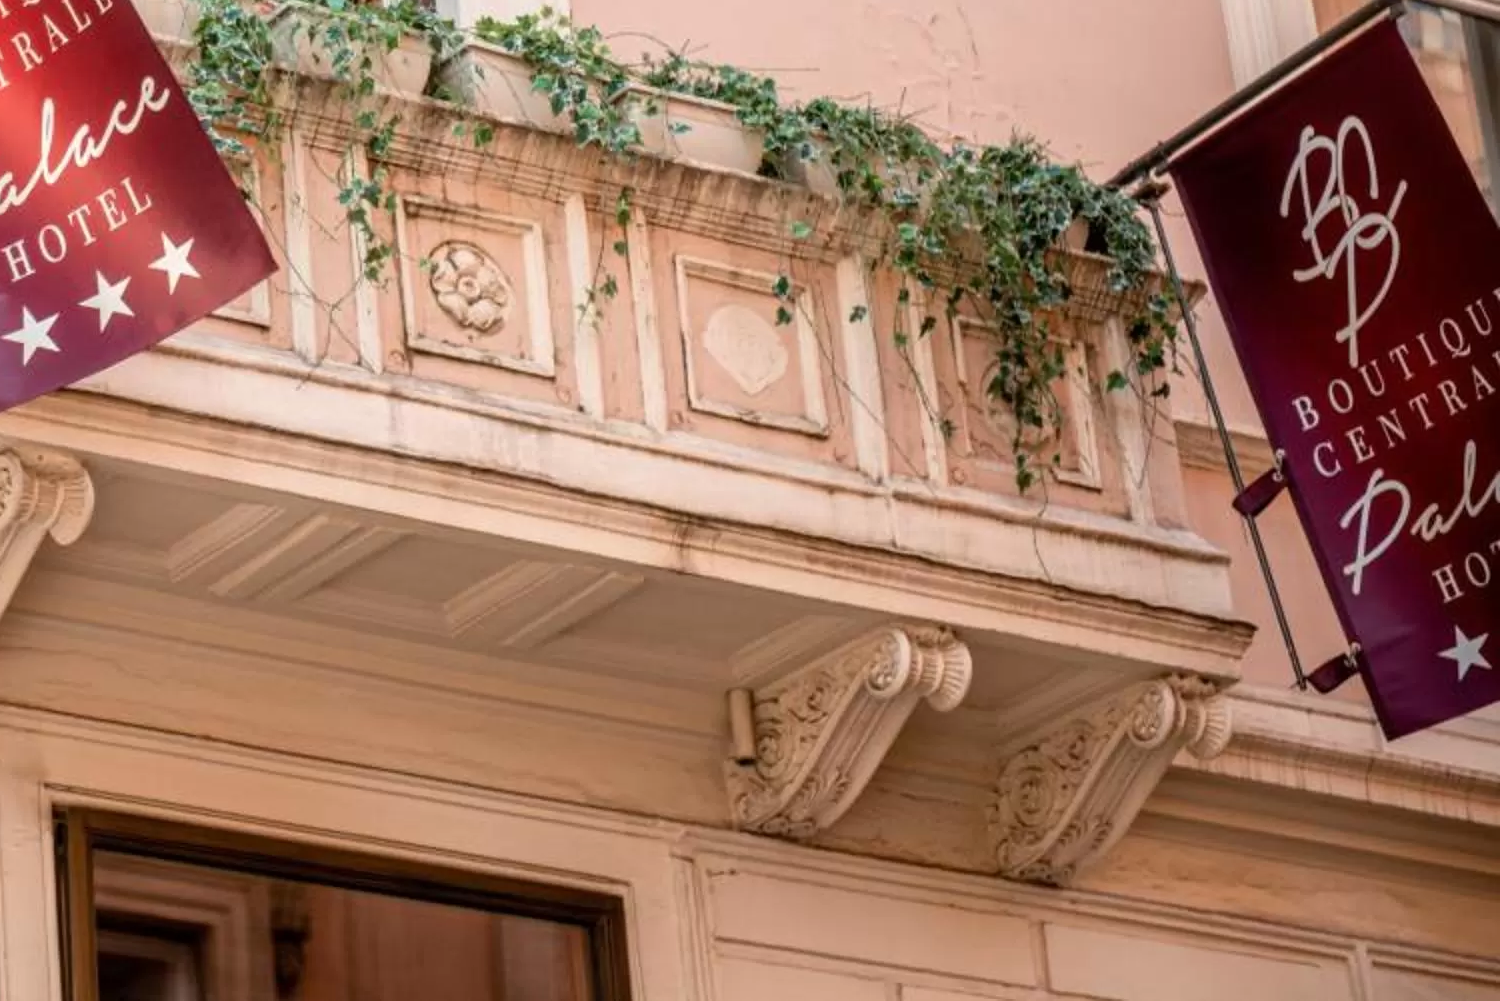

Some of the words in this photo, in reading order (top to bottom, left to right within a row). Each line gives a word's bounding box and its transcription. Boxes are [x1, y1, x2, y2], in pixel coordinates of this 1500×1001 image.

[1, 176, 153, 283] HOTEL
[1291, 286, 1500, 431] BOUTIQU
[1312, 350, 1500, 478] CENTRA
